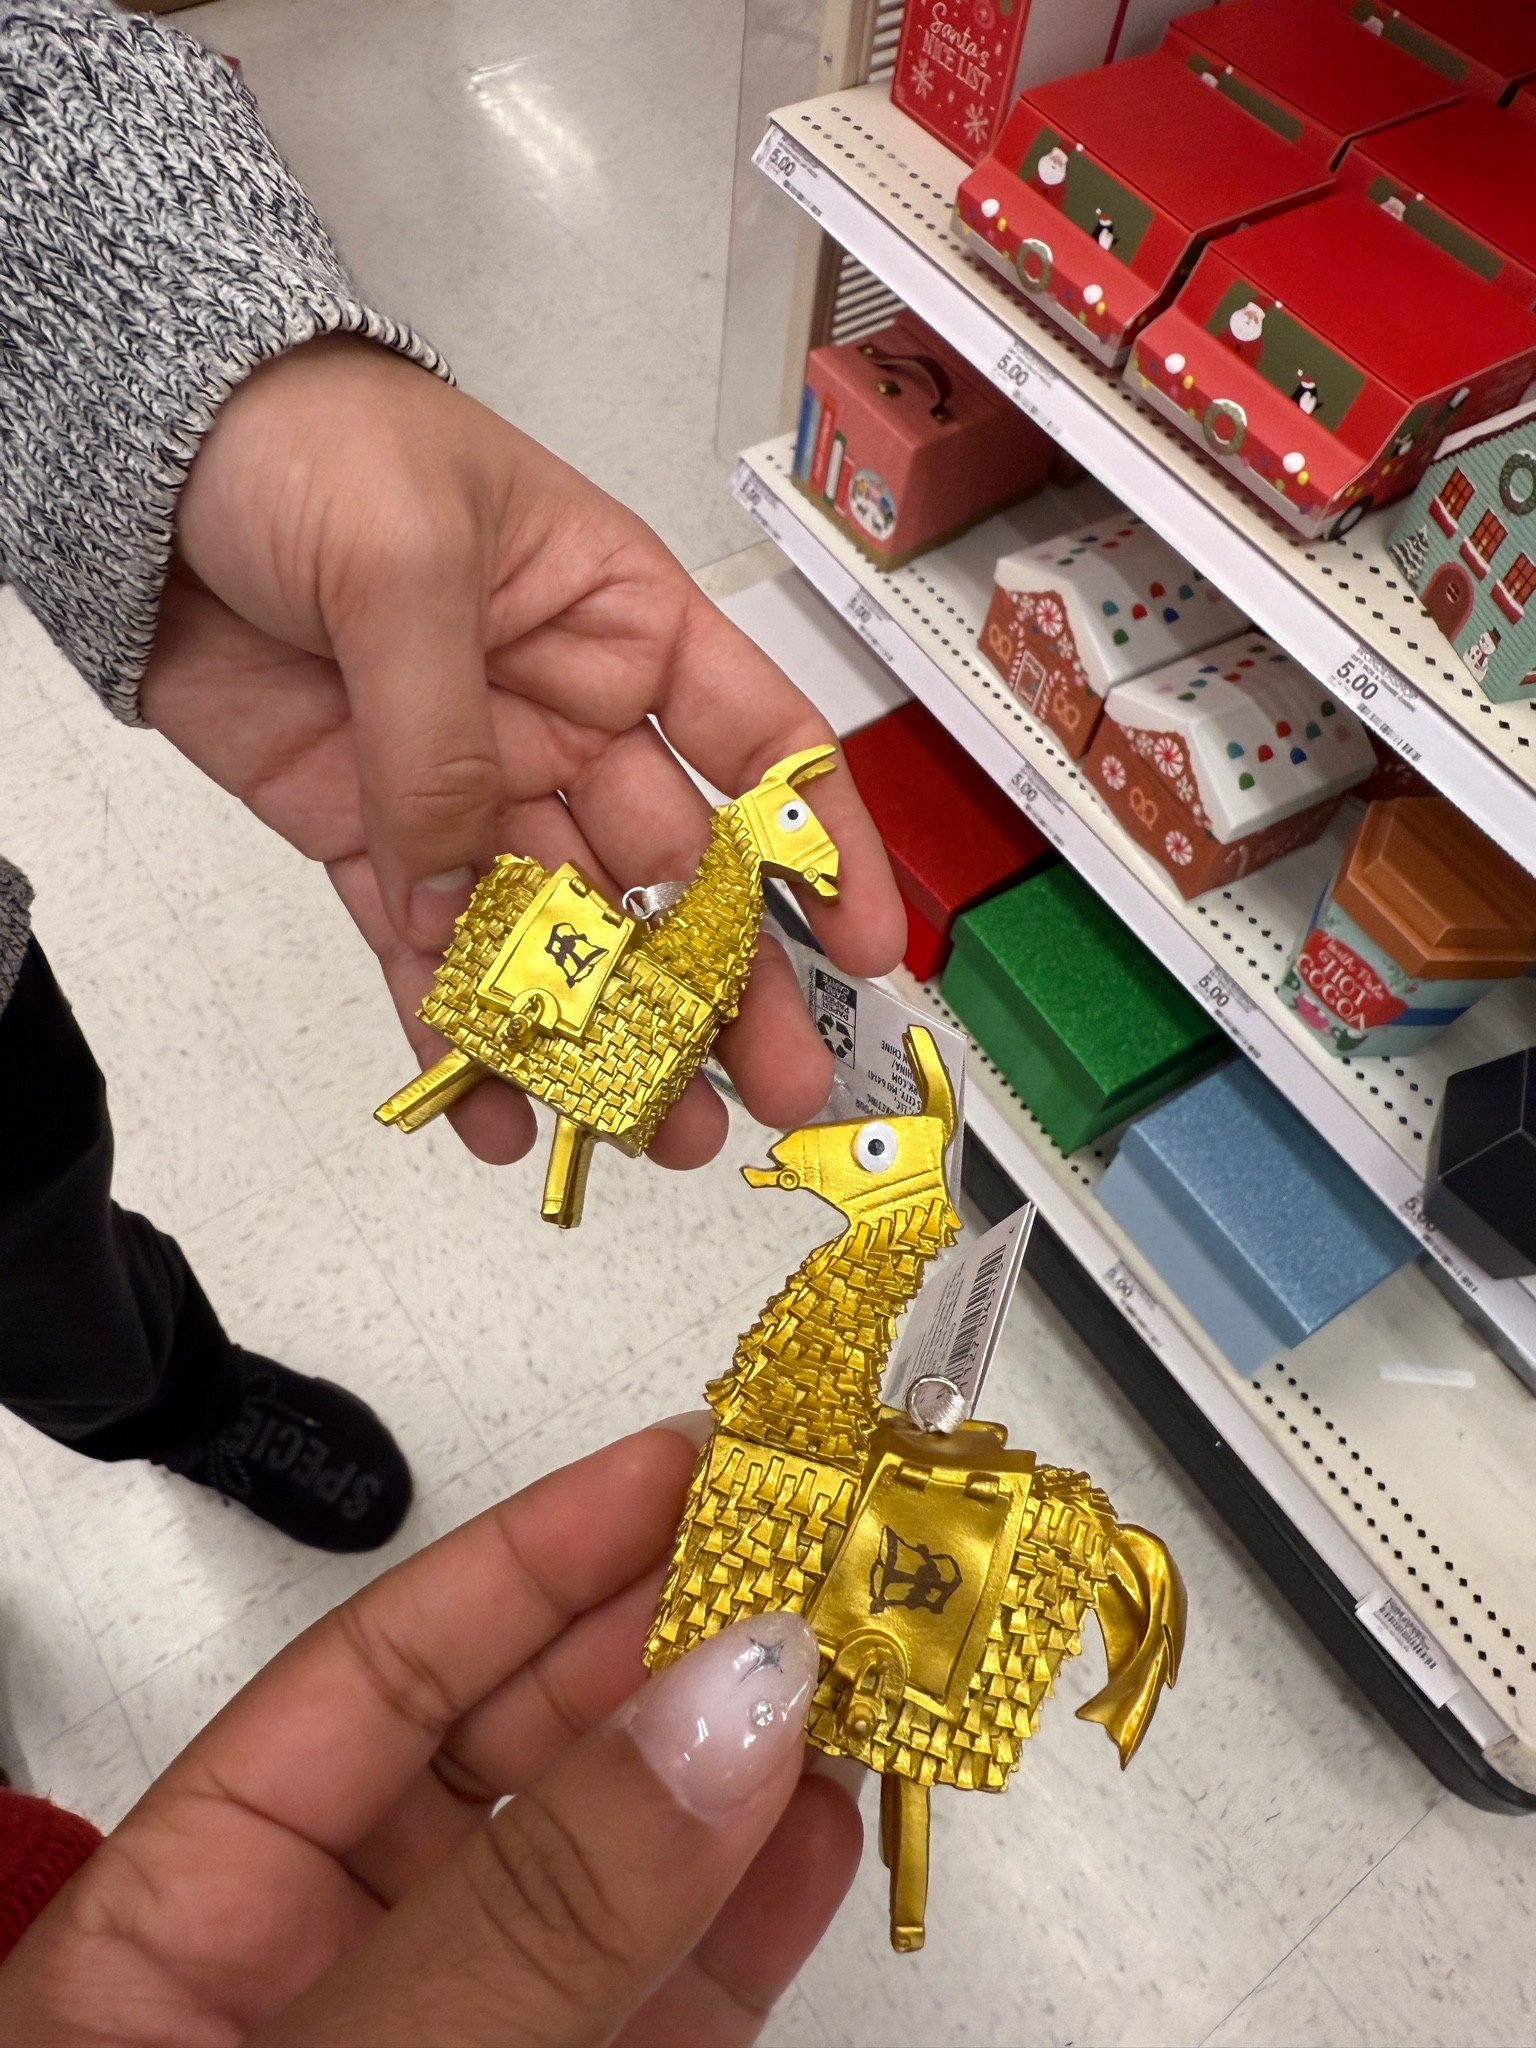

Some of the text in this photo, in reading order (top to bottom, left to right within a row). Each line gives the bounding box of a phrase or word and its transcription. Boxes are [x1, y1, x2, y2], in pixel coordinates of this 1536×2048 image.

[922, 29, 992, 97] NICE LIST
[769, 148, 796, 177] 5.00
[997, 354, 1028, 387] 5.00
[1336, 661, 1379, 700] 5.00
[1011, 773, 1037, 802] 5.00
[1199, 975, 1229, 1007] 5.00
[1297, 953, 1365, 1033] COCOA
[1324, 959, 1368, 1006] HOT
[881, 1040, 901, 1059] CHINE
